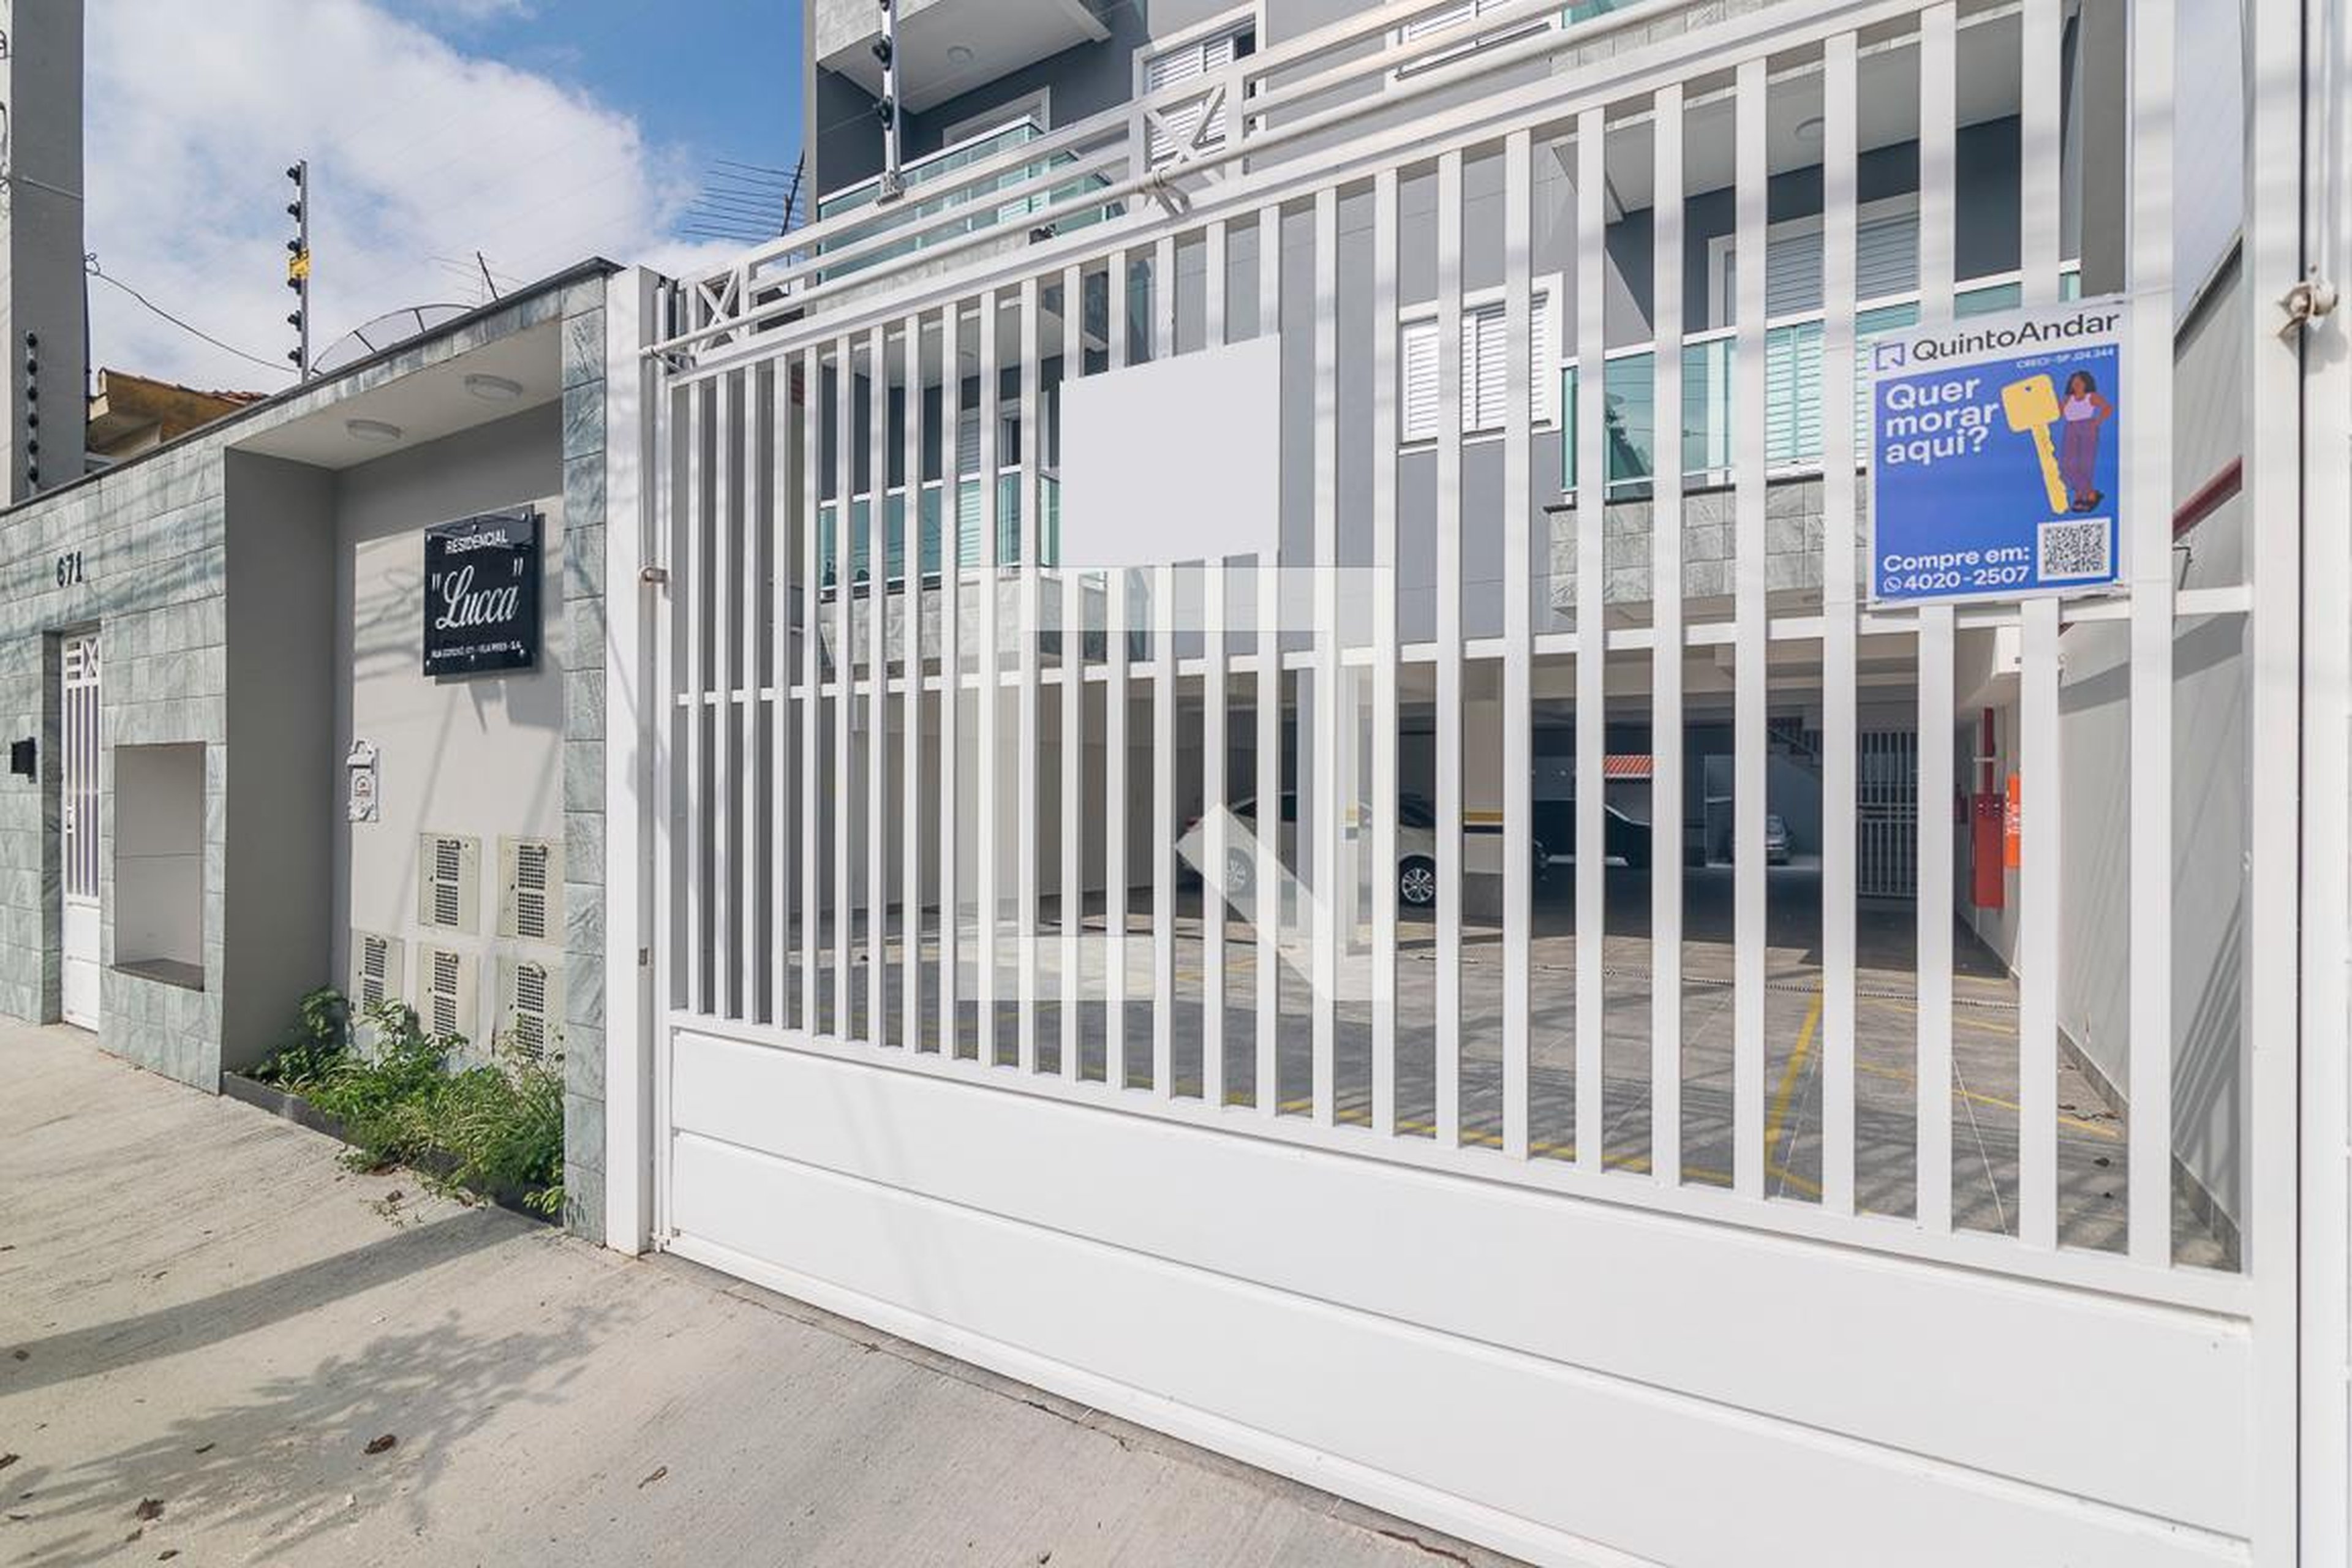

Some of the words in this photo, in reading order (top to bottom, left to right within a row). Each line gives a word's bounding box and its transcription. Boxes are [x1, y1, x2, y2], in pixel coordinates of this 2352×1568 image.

[1912, 314, 2120, 360] QuintoAndar
[1886, 378, 1981, 411] Quer
[1886, 402, 1999, 438] morar
[1886, 426, 1989, 466] aqui?
[445, 529, 508, 554] RESIDENCIAL
[1883, 551, 1980, 571] Compre
[1985, 546, 2029, 564] em:
[56, 551, 82, 588] 671
[1904, 566, 2029, 590] 4020-2507
